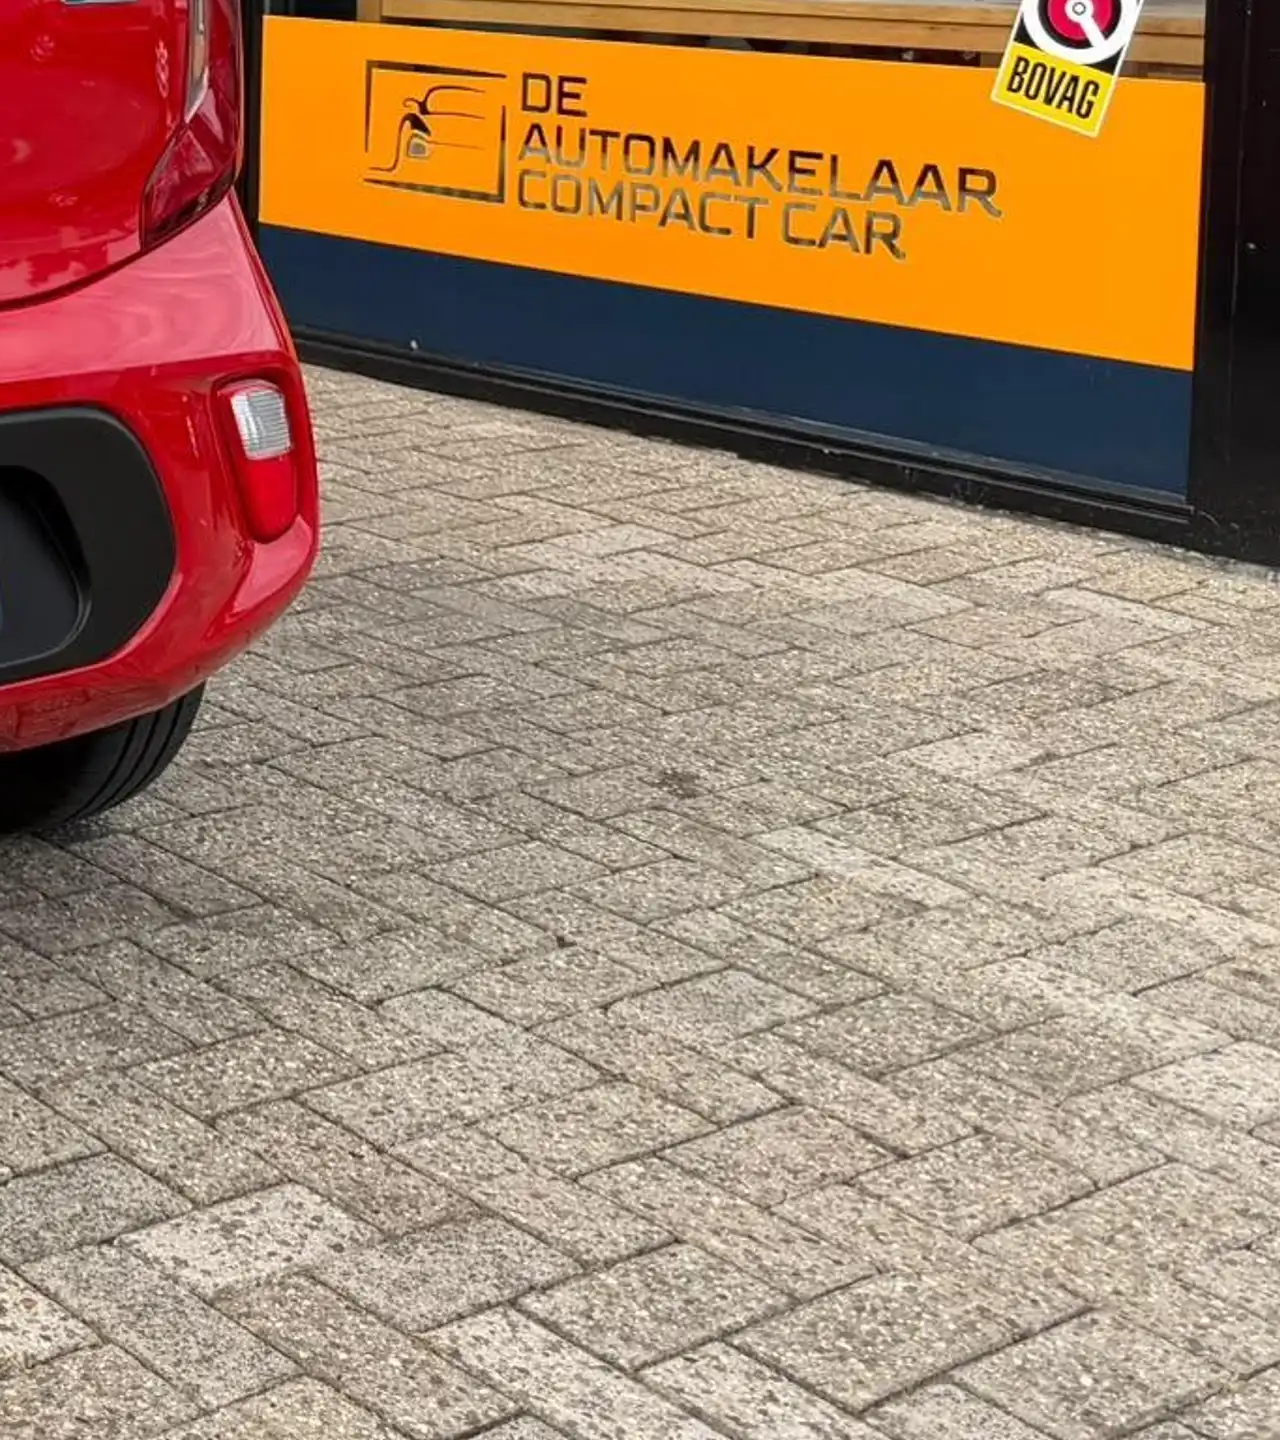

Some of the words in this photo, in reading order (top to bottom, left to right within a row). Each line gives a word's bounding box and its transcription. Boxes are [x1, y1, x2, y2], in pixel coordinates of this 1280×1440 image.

[521, 72, 588, 117] DE
[1006, 56, 1100, 120] BOVAG
[518, 123, 1002, 218] AUTOMAKELAAR
[518, 169, 769, 240] COMPACT
[781, 202, 906, 260] CAR
